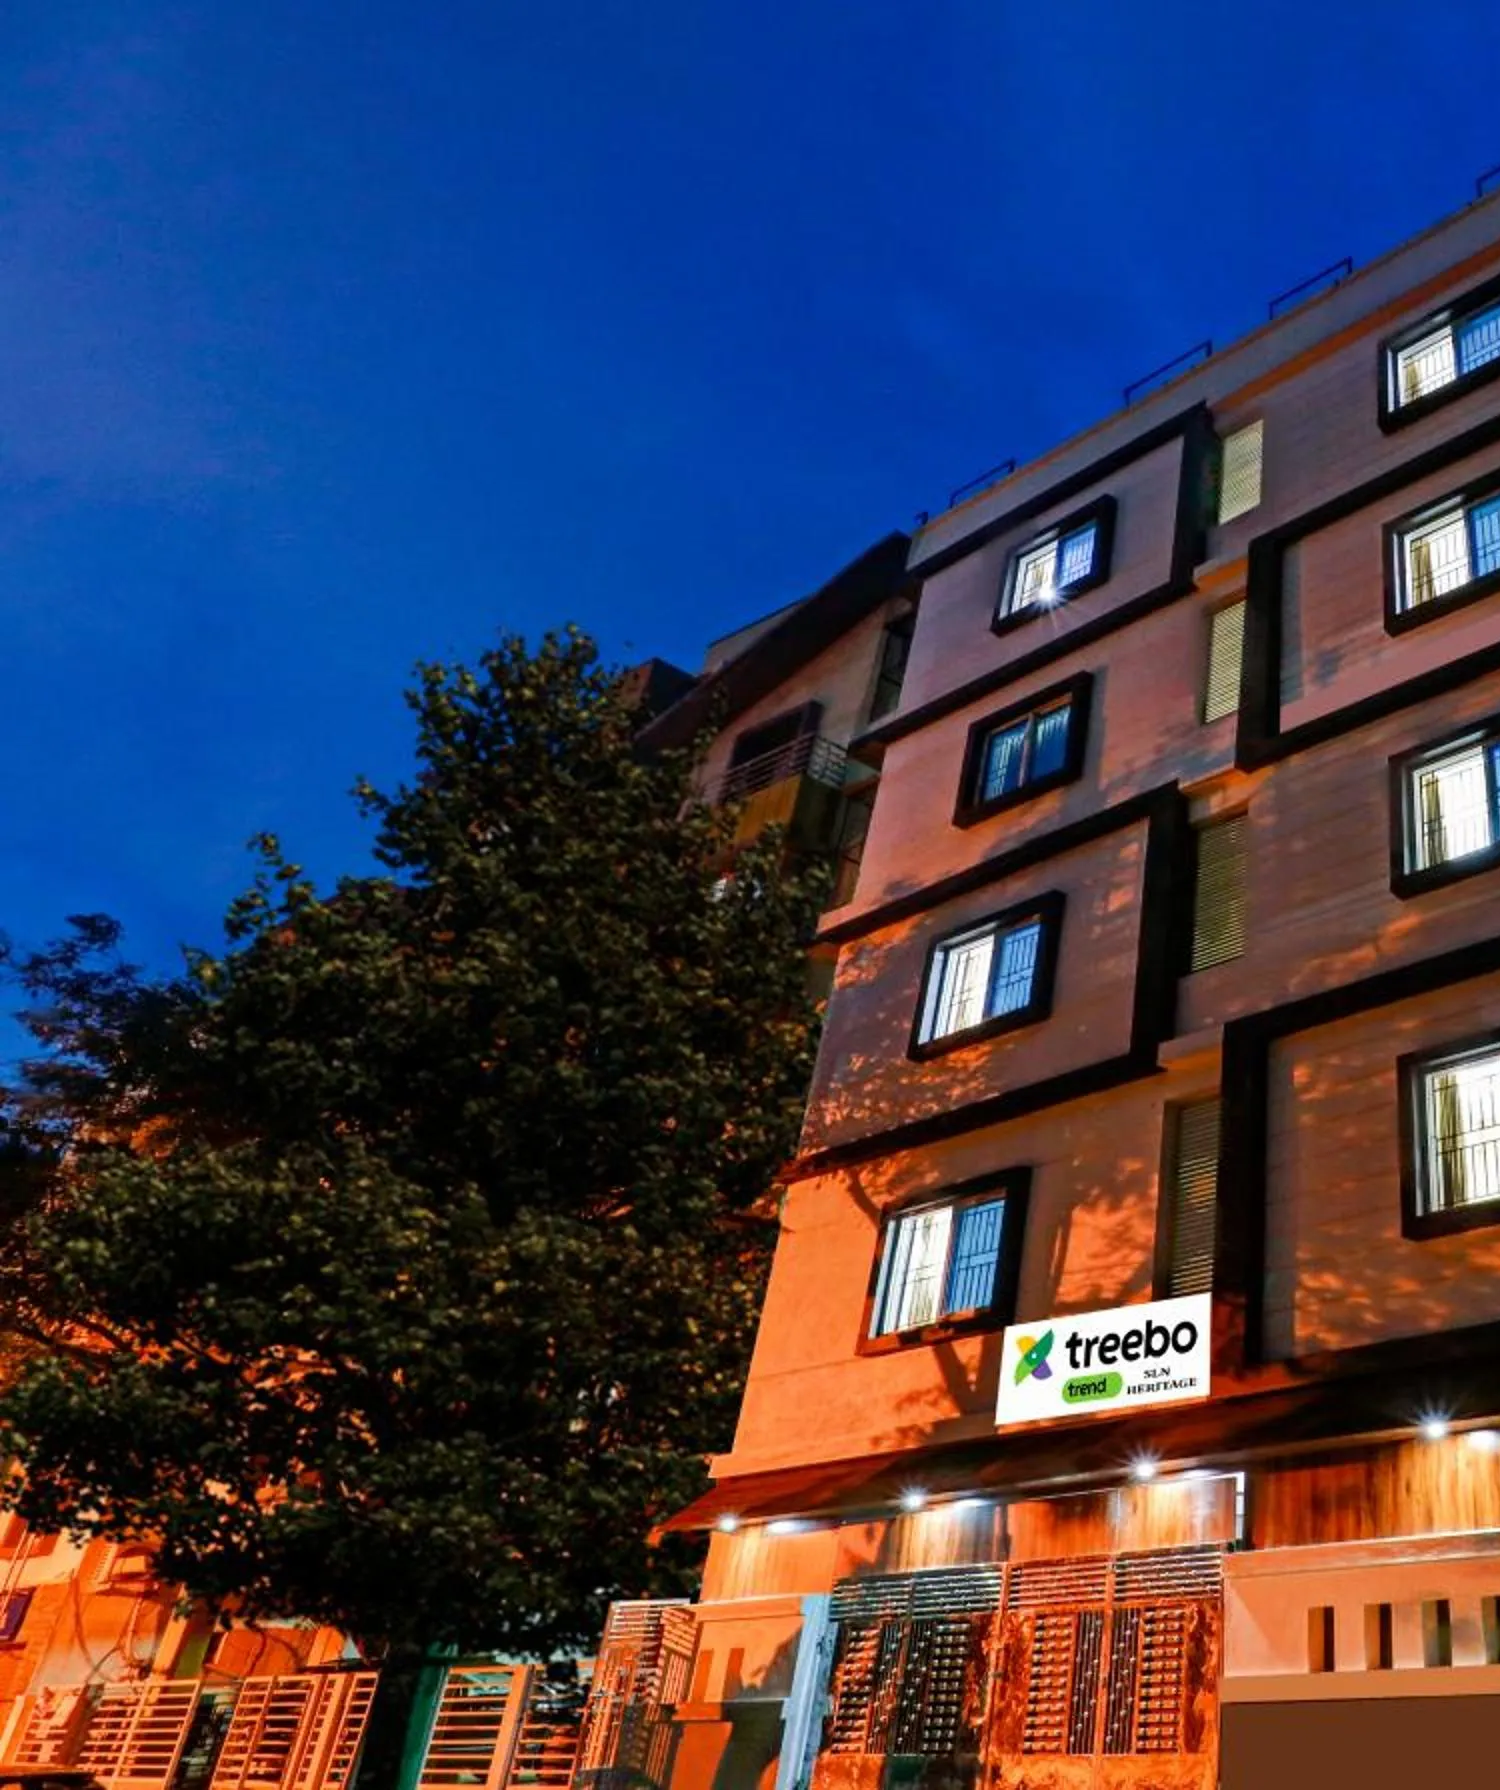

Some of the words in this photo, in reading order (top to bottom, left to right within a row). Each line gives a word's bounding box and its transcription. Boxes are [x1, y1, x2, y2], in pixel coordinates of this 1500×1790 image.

[1065, 1319, 1198, 1369] treebo
[1143, 1366, 1171, 1379] SLN
[1067, 1377, 1107, 1397] trend
[1126, 1377, 1197, 1395] HERITAGE
